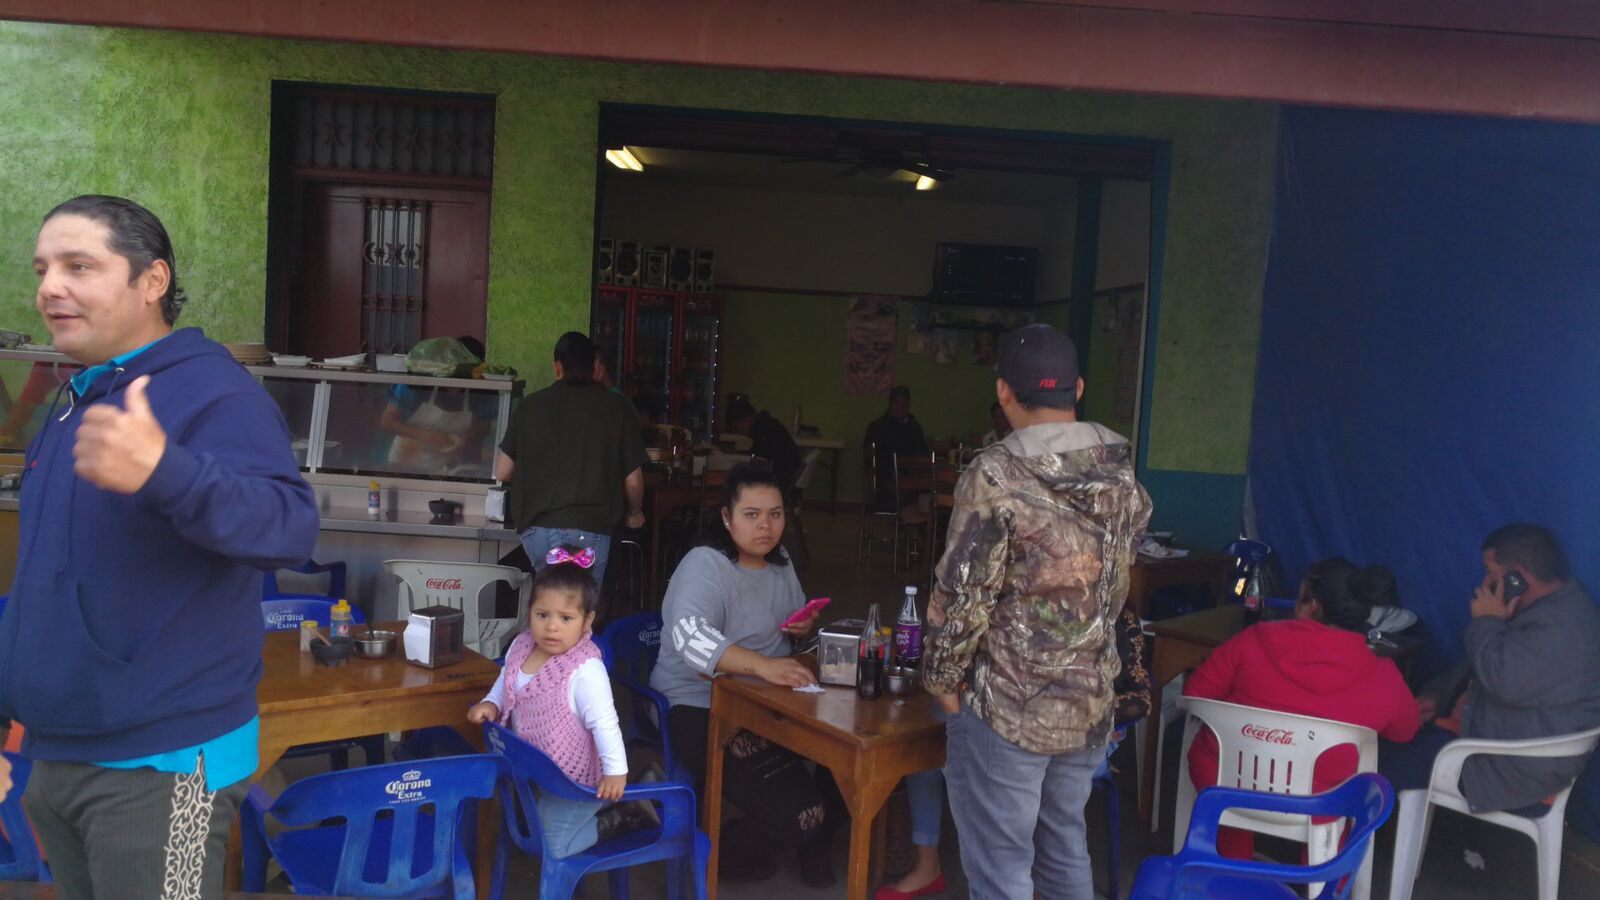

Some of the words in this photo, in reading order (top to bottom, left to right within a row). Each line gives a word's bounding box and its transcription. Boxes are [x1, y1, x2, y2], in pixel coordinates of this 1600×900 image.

[266, 612, 304, 624] Corona
[638, 630, 662, 642] Coron
[385, 779, 432, 795] Corona
[397, 791, 422, 800] Extra
